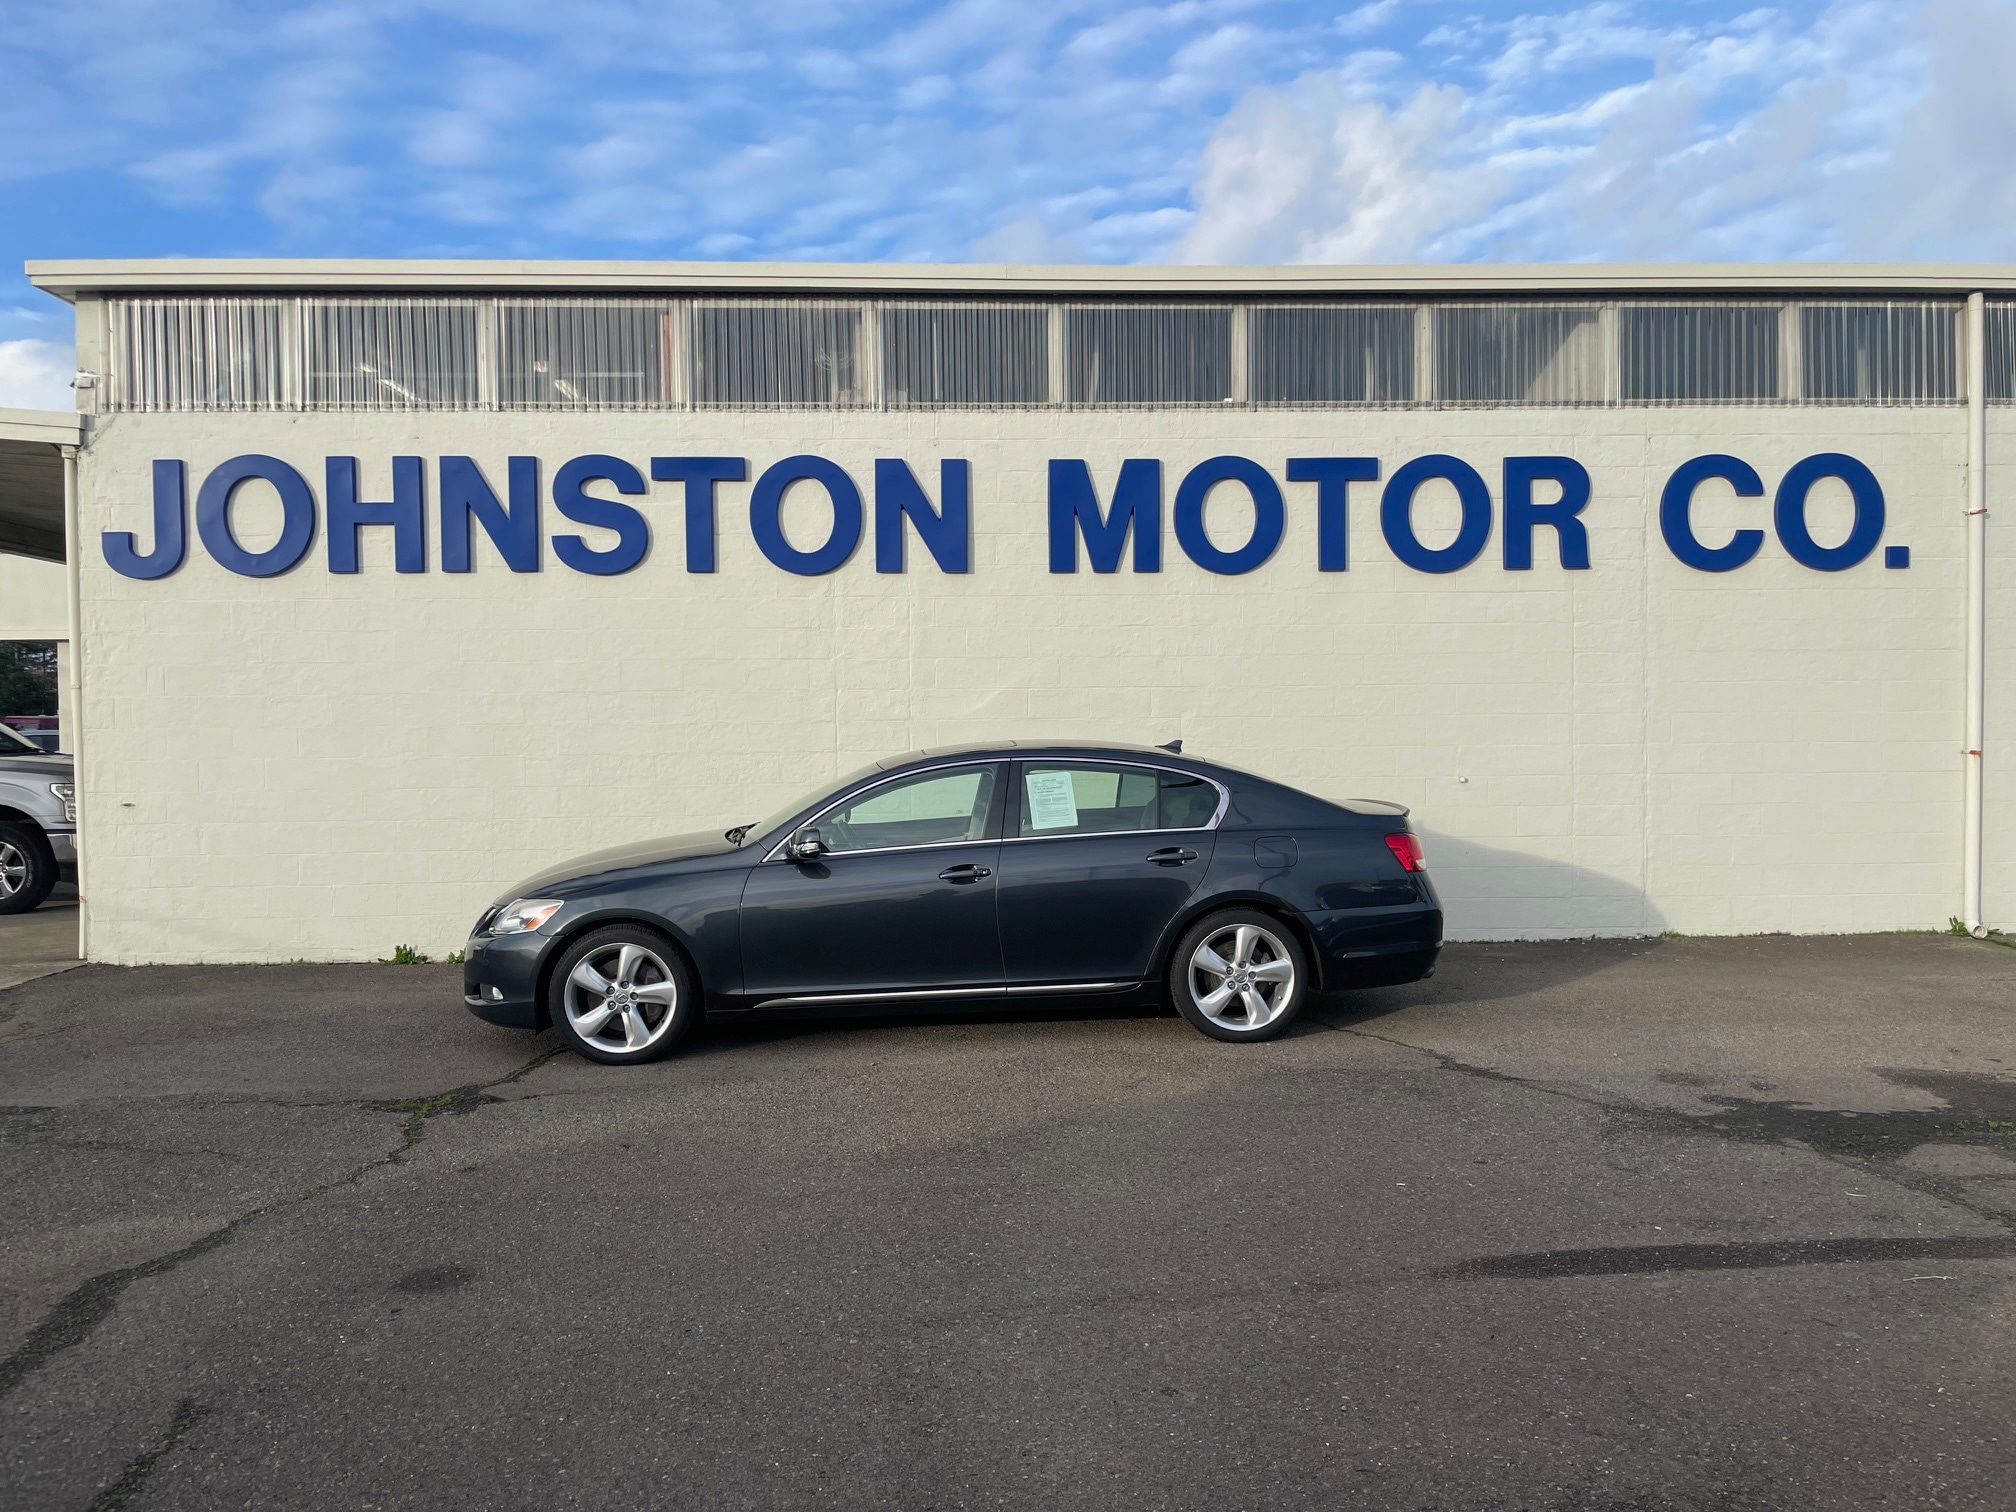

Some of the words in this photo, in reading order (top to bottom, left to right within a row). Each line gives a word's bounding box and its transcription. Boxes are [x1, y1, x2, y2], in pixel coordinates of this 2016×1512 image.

[102, 453, 969, 579] JOHNSTON
[1048, 454, 1591, 574] MOTOR
[1660, 452, 1910, 571] CO.
